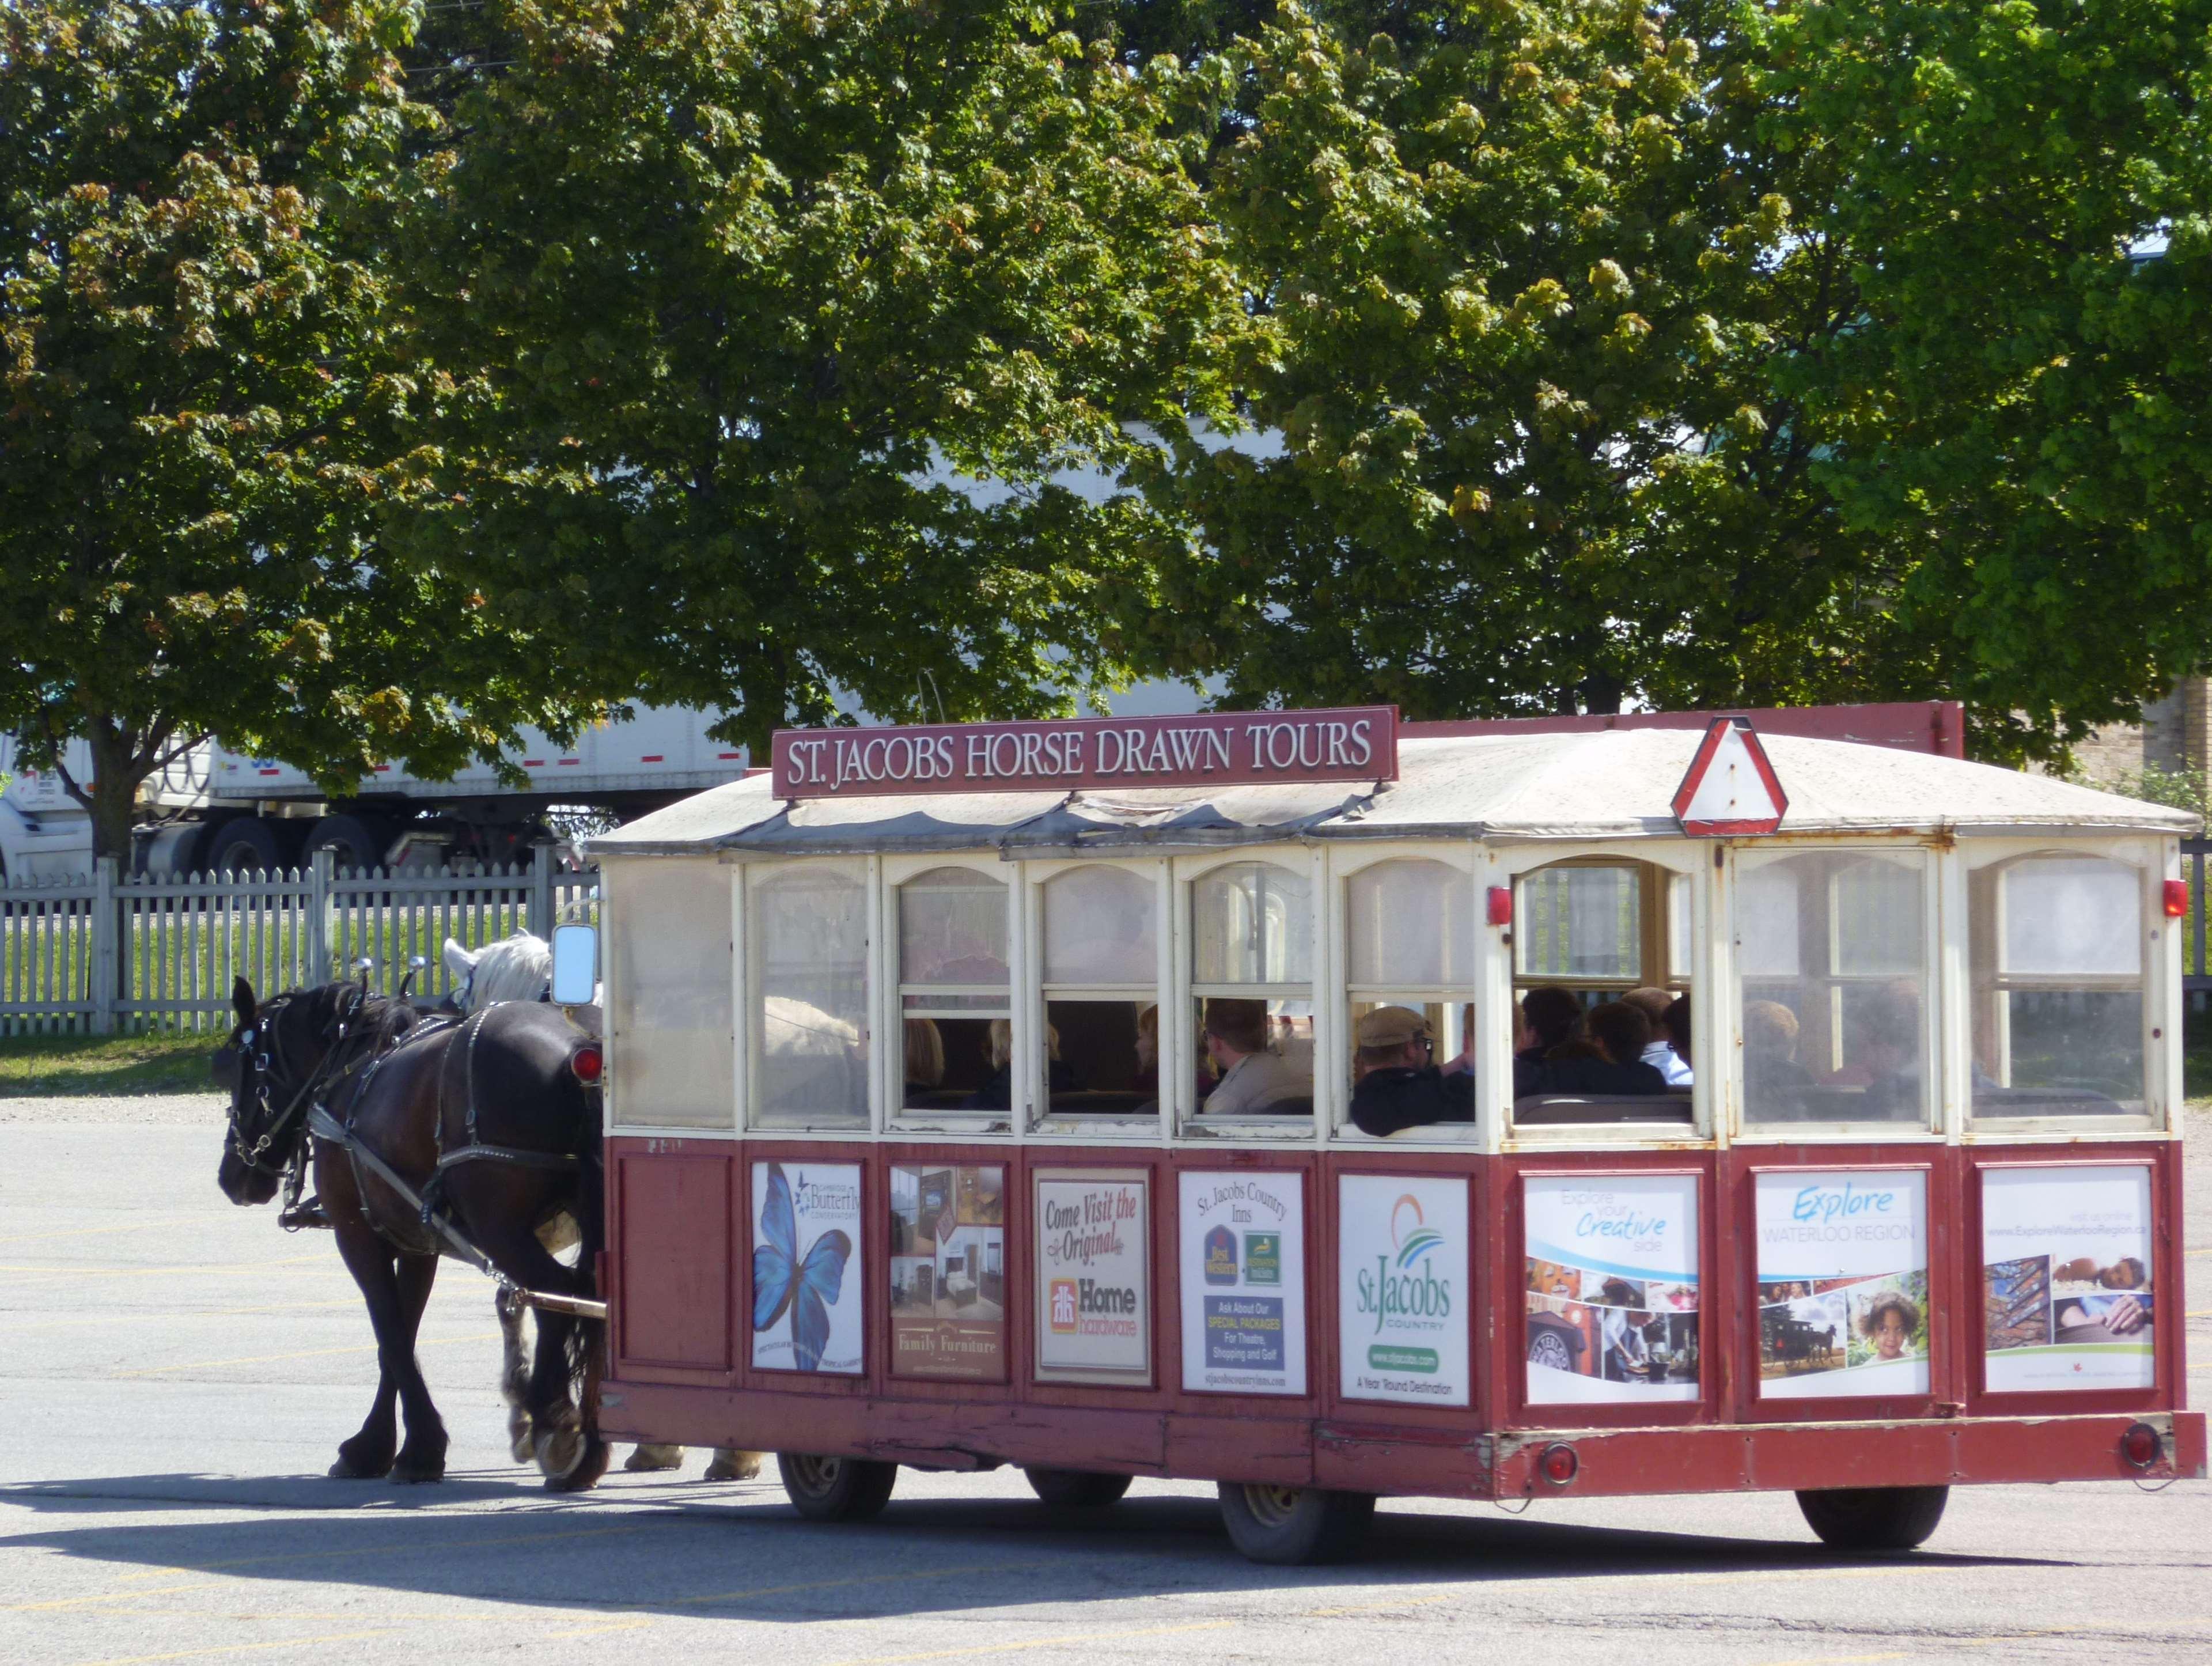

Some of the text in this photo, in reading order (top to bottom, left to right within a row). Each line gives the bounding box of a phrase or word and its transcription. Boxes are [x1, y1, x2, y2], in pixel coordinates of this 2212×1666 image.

[788, 720, 1371, 790] ST. JACOBS HORSE DRAWN TOURS
[811, 1184, 859, 1210] Butterfly
[1198, 1182, 1287, 1222] St. Jacobs Country
[1562, 1187, 1613, 1207] Explore
[1793, 1182, 1894, 1224] Explore
[1046, 1187, 1137, 1230] Come Visit the
[1232, 1204, 1252, 1222] Inns
[1576, 1211, 1666, 1240] Creative
[1763, 1224, 1916, 1243] WATERLOO REGION
[1078, 1278, 1135, 1314] Home
[1374, 1255, 1450, 1336] Jacobs
[1218, 1301, 1269, 1314] Ask About Our
[1078, 1314, 1137, 1337] hardware
[1208, 1316, 1281, 1330] SPECIAL PACKAGES
[1386, 1319, 1445, 1331] COUNTRY
[899, 1334, 997, 1355] Family Furniture
[1224, 1331, 1237, 1343] For
[1213, 1346, 1278, 1362] Shopping and Golf
[1357, 1376, 1363, 1388] A
[1364, 1377, 1380, 1389] Year
[1409, 1380, 1453, 1396] Destination
